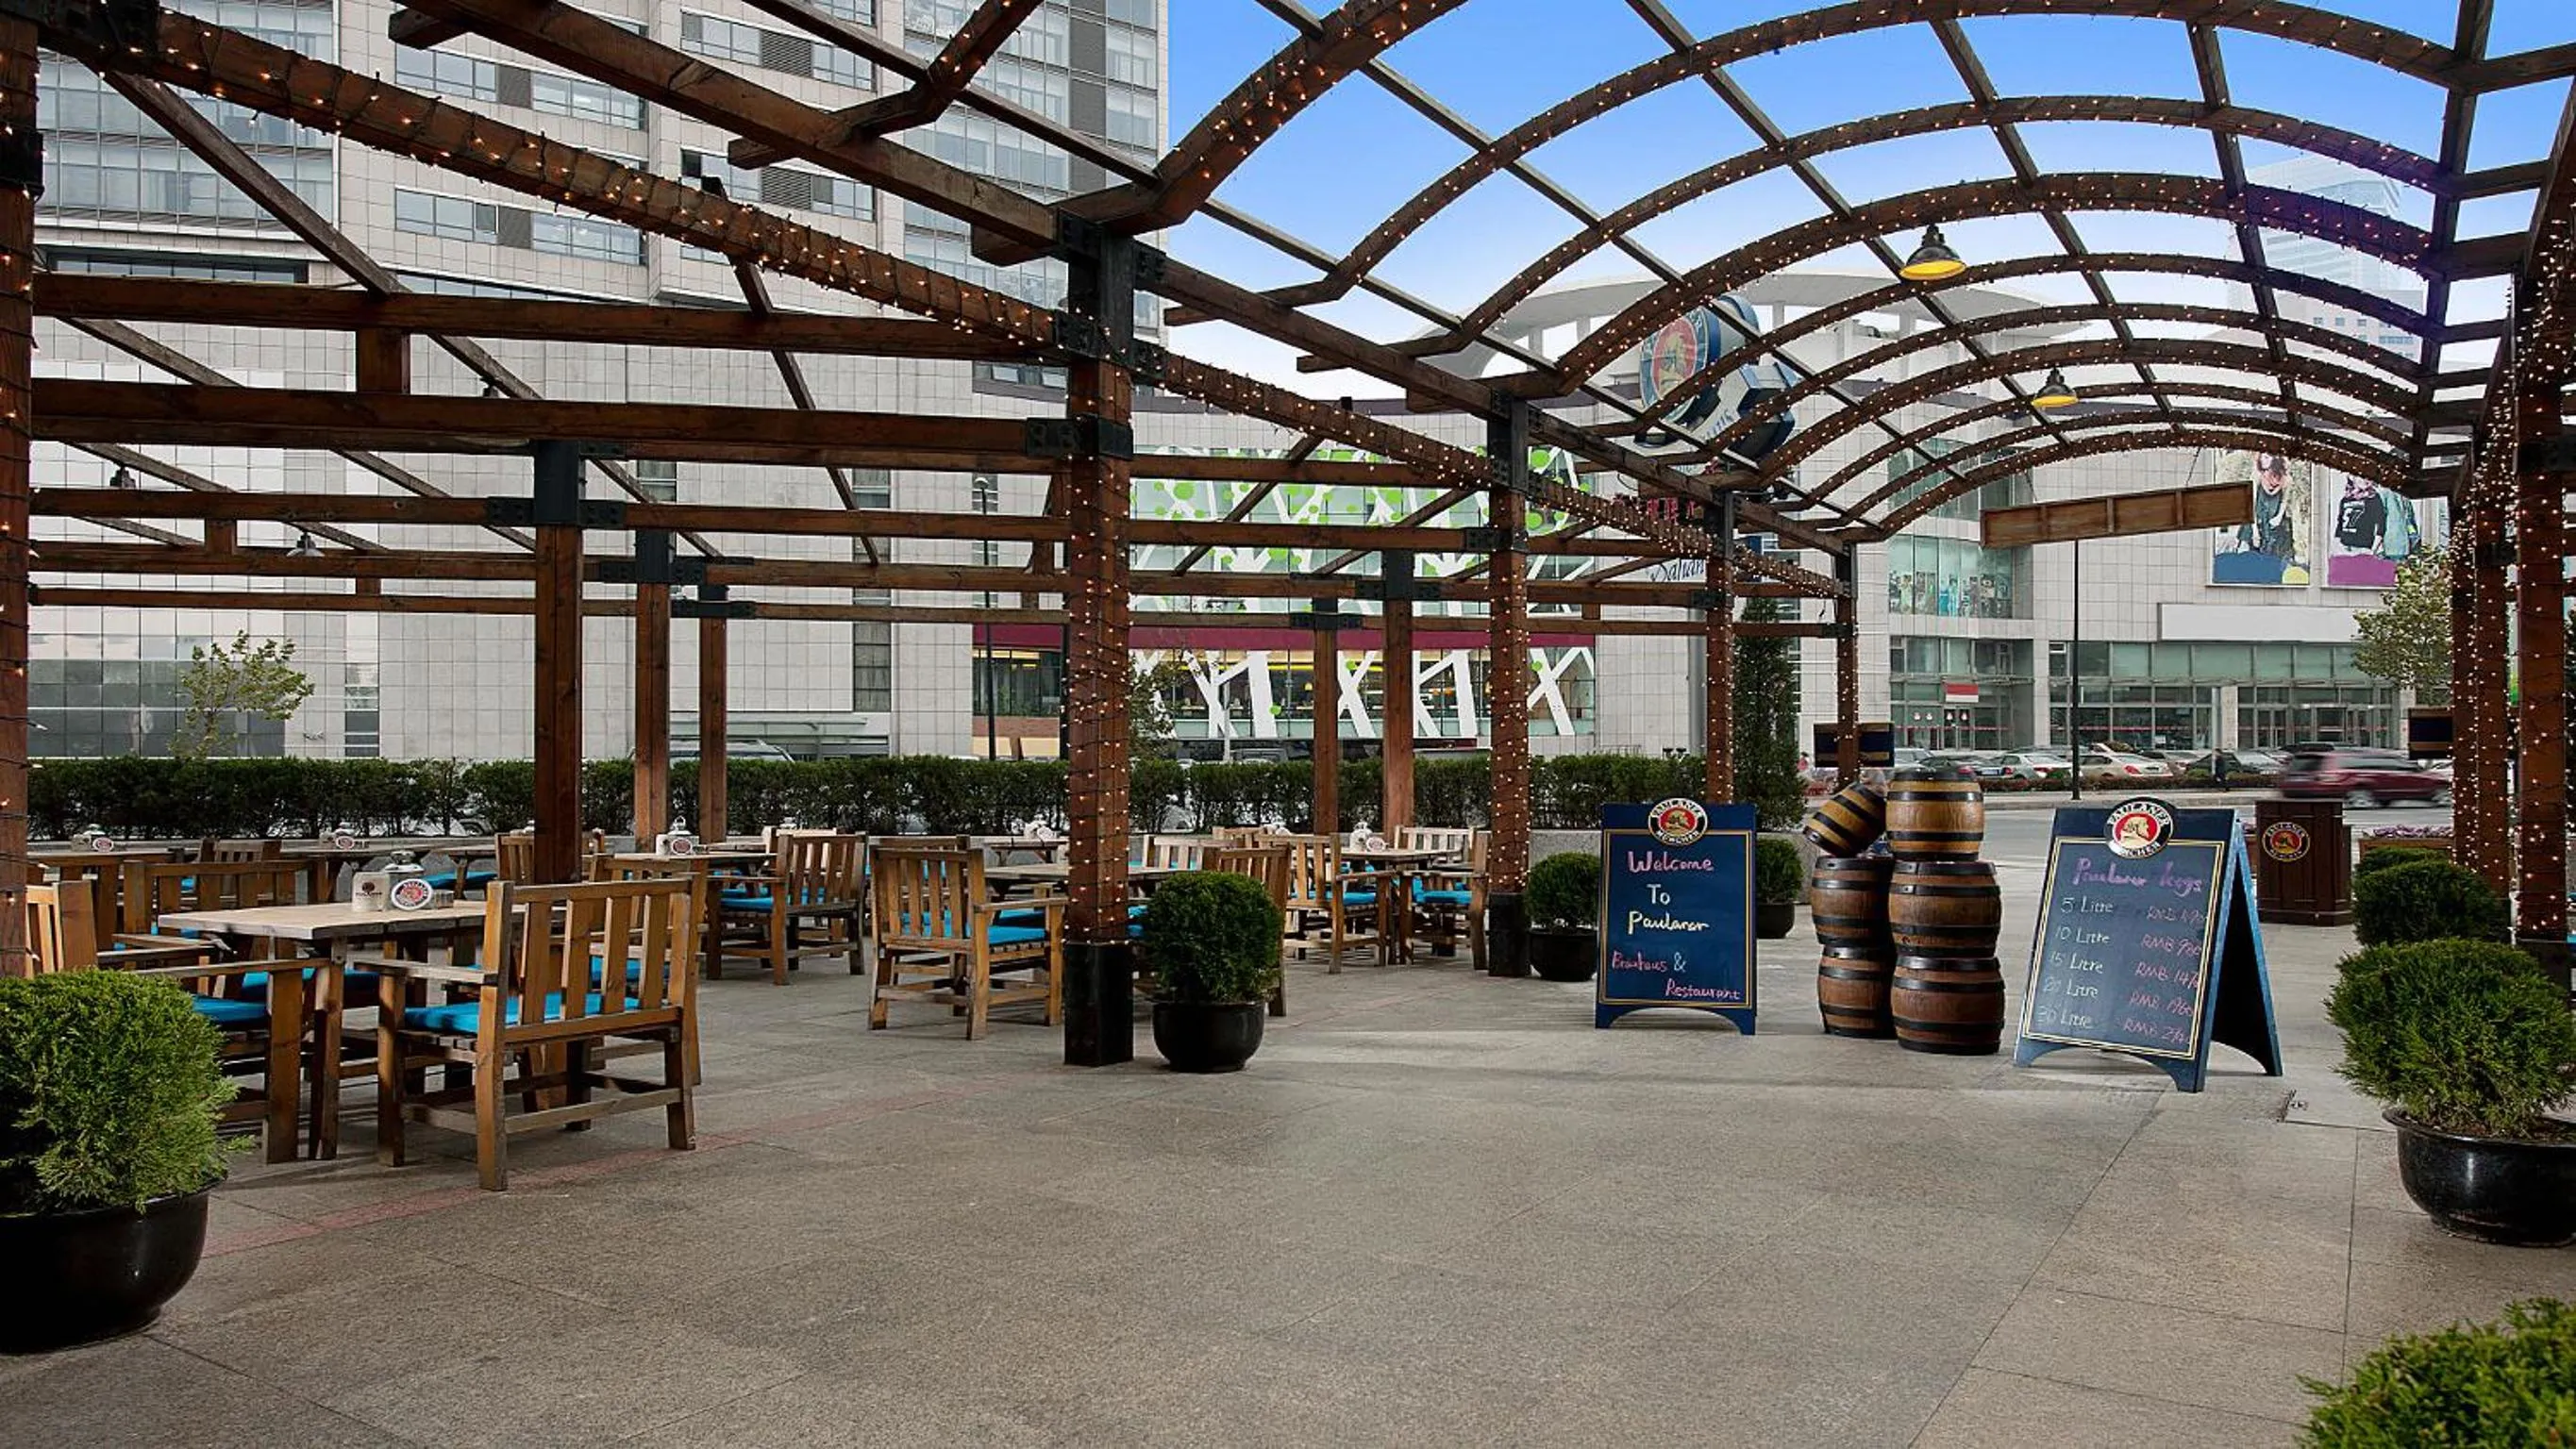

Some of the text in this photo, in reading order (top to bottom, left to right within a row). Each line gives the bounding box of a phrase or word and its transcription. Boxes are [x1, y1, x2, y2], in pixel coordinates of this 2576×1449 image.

[2106, 802, 2170, 827] PAULANER
[1627, 851, 1715, 874] Welcome
[1647, 883, 1670, 905] To
[2060, 897, 2075, 914] 5
[2081, 895, 2114, 913] Litre
[2055, 925, 2072, 941] 10
[2076, 927, 2111, 943] Litre
[1673, 951, 1687, 973] &
[2069, 953, 2103, 974] Litre
[2135, 962, 2169, 981] RMB
[1665, 977, 1741, 1000] Restaurant
[2066, 979, 2099, 998] Litre
